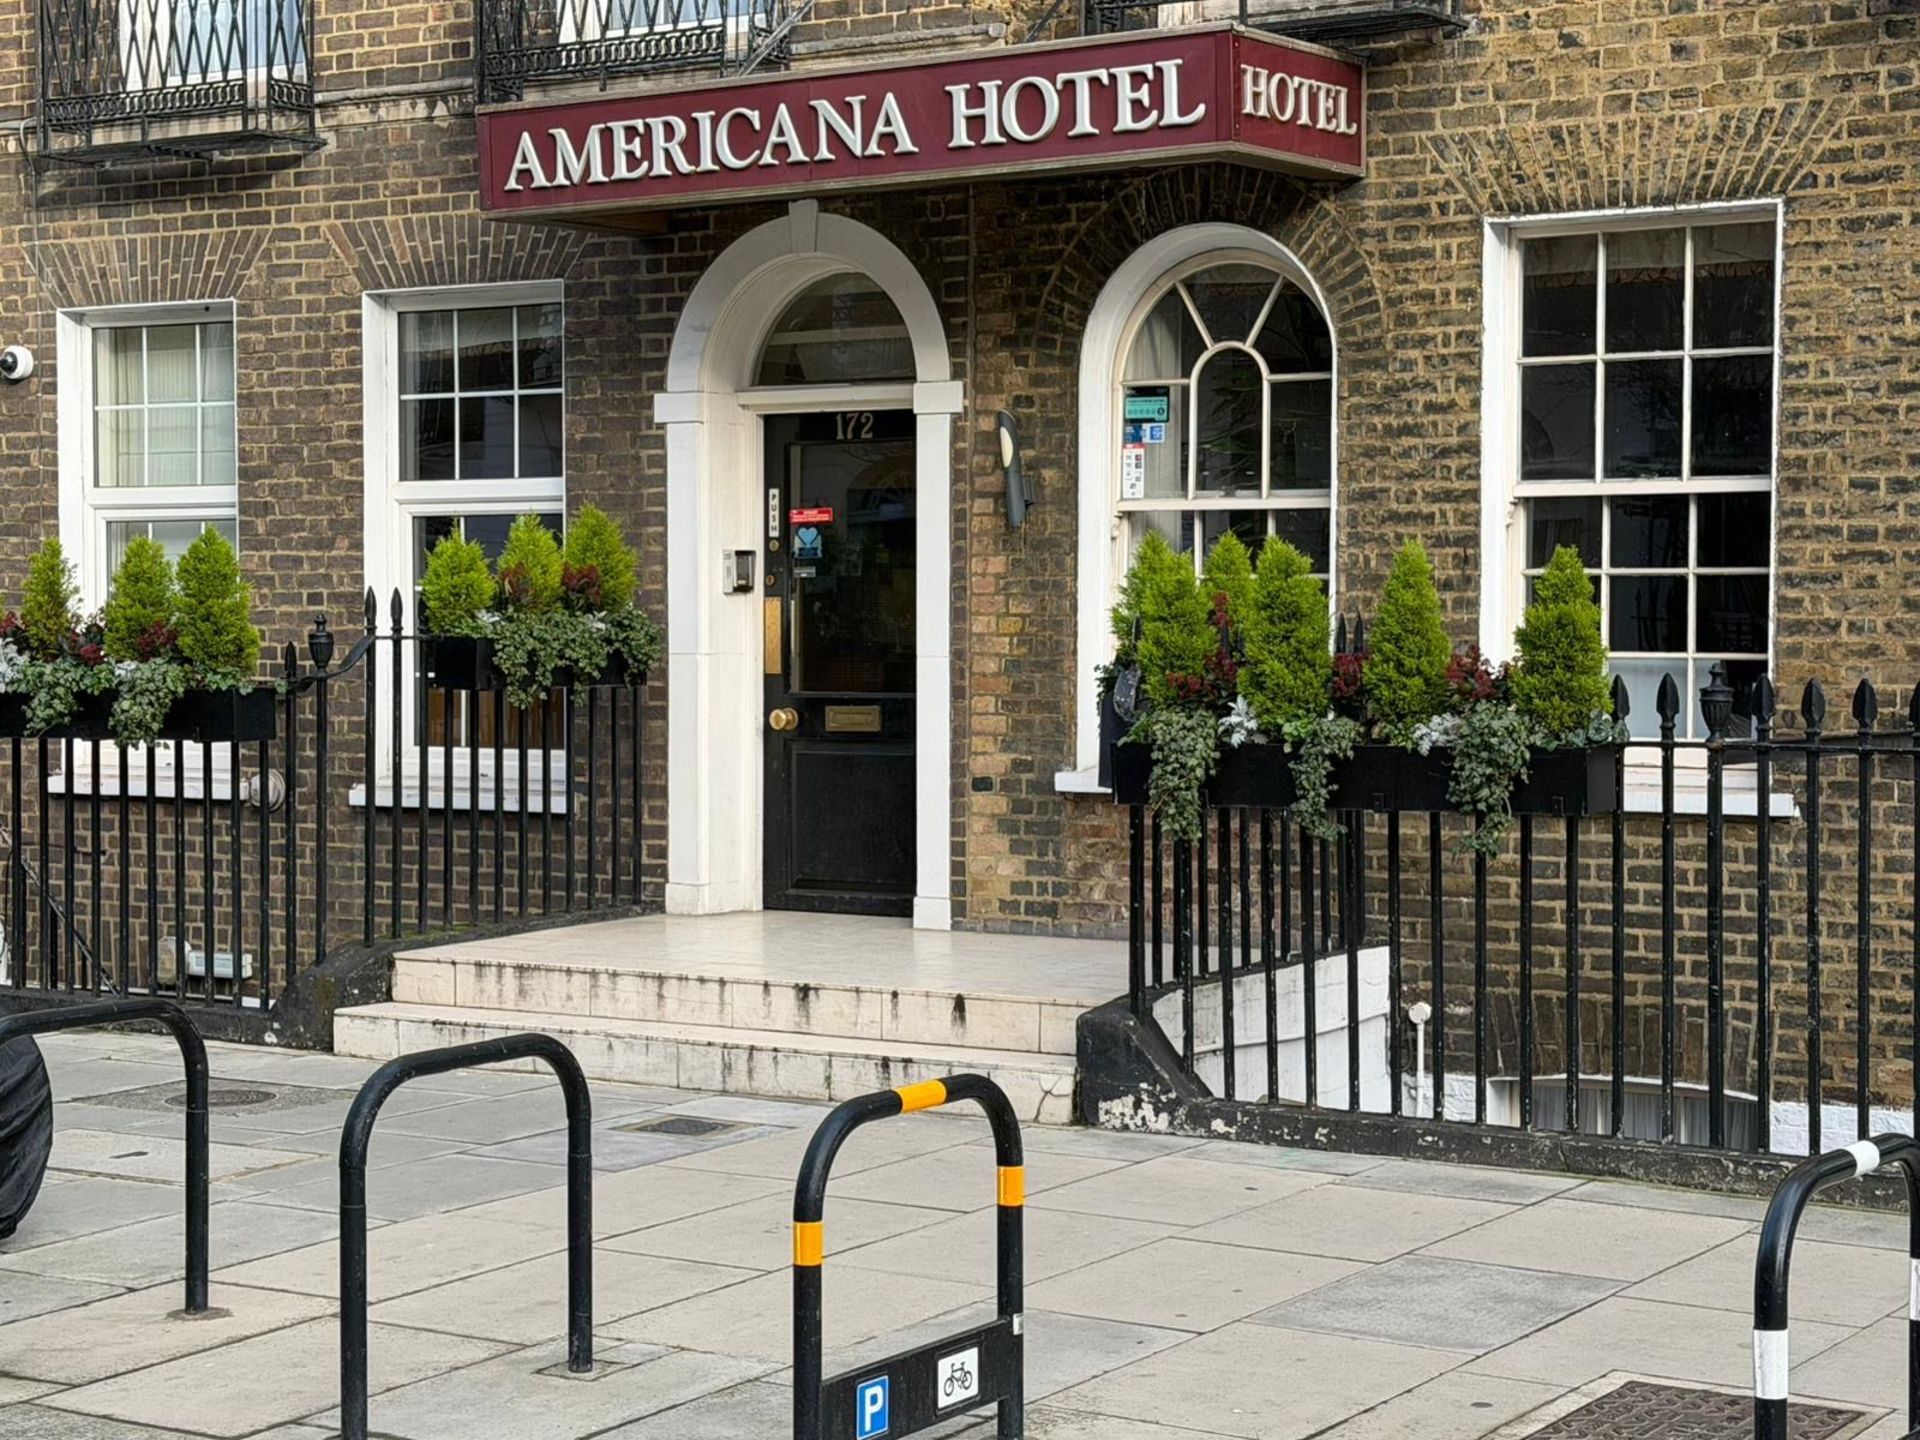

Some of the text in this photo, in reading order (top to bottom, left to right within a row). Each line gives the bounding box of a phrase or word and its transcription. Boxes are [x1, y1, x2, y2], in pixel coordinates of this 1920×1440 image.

[504, 57, 1206, 191] AMERICANA HOTEL
[1240, 64, 1358, 135] HOTEL
[836, 412, 874, 440] 172
[865, 1386, 883, 1432] P
